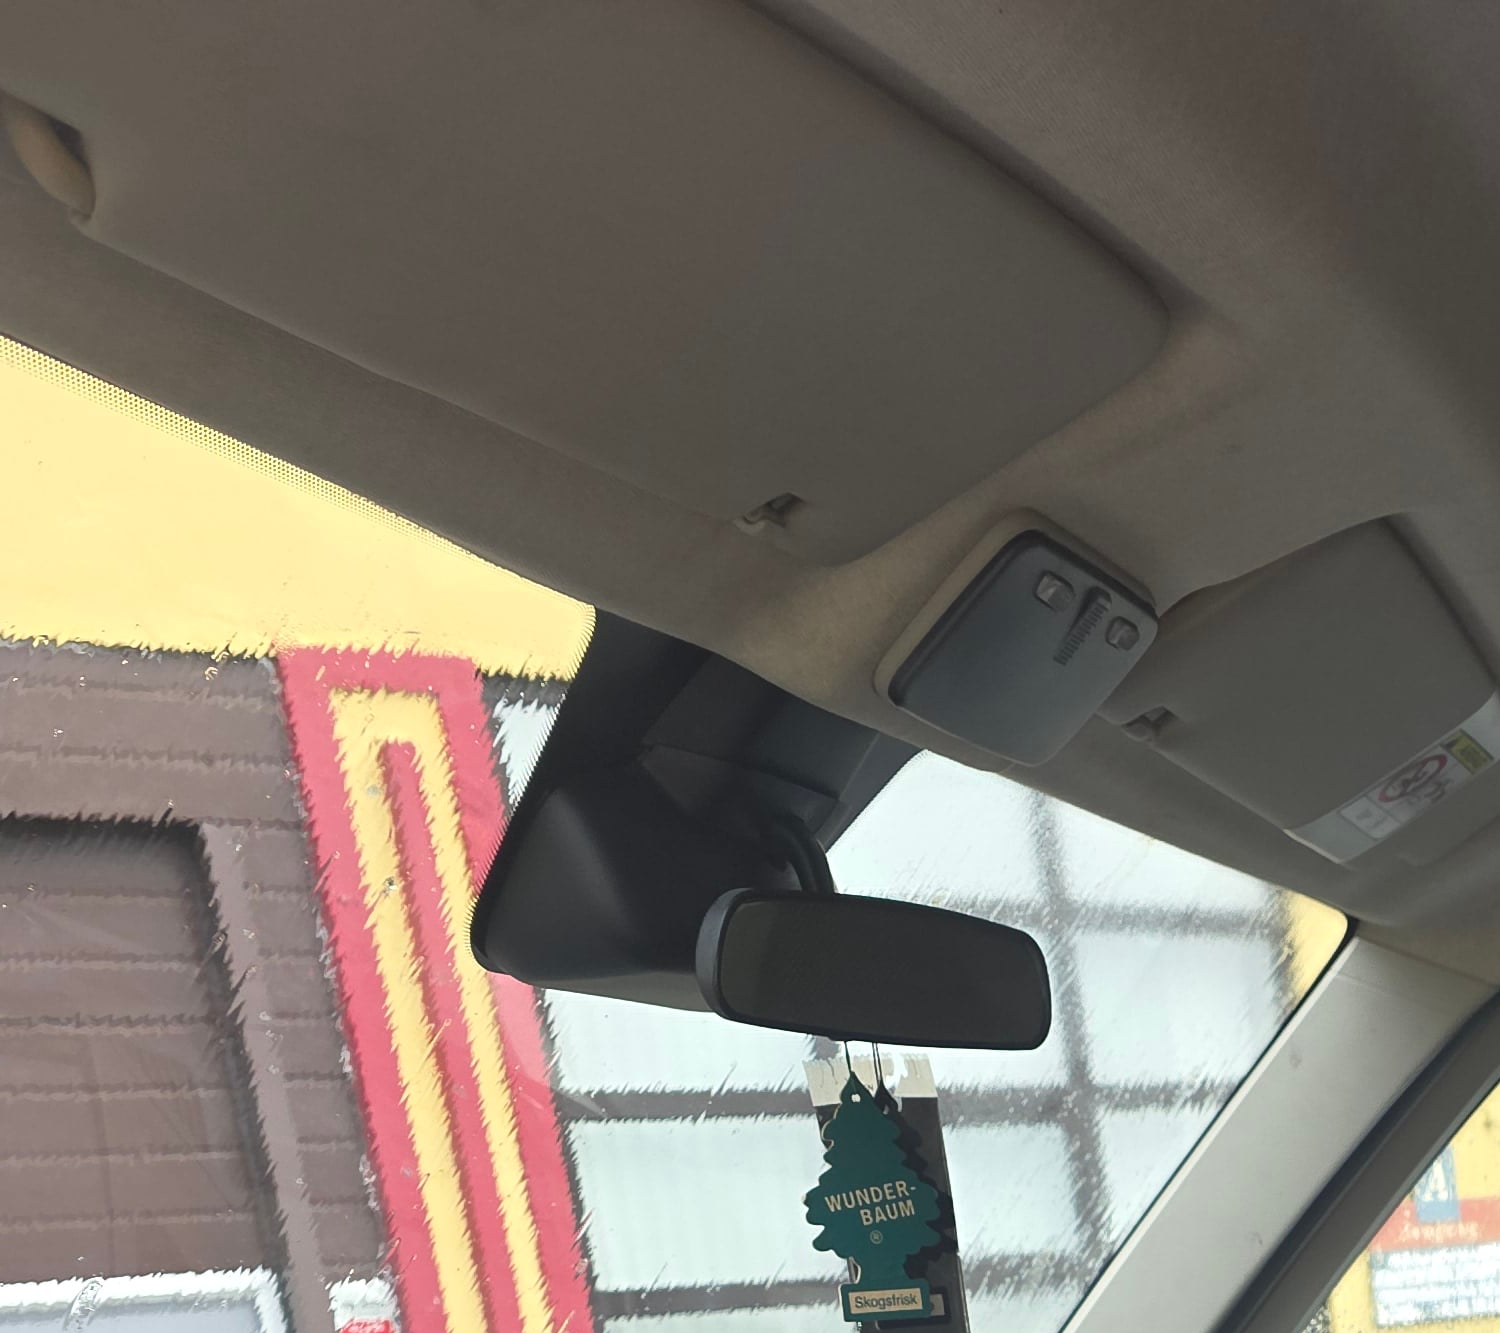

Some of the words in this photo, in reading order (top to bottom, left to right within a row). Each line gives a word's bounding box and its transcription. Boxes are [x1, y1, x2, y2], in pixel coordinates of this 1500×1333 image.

[824, 1180, 917, 1213] WUNDER-
[859, 1199, 915, 1226] BAUM
[854, 1293, 918, 1310] Skogsfrisk
